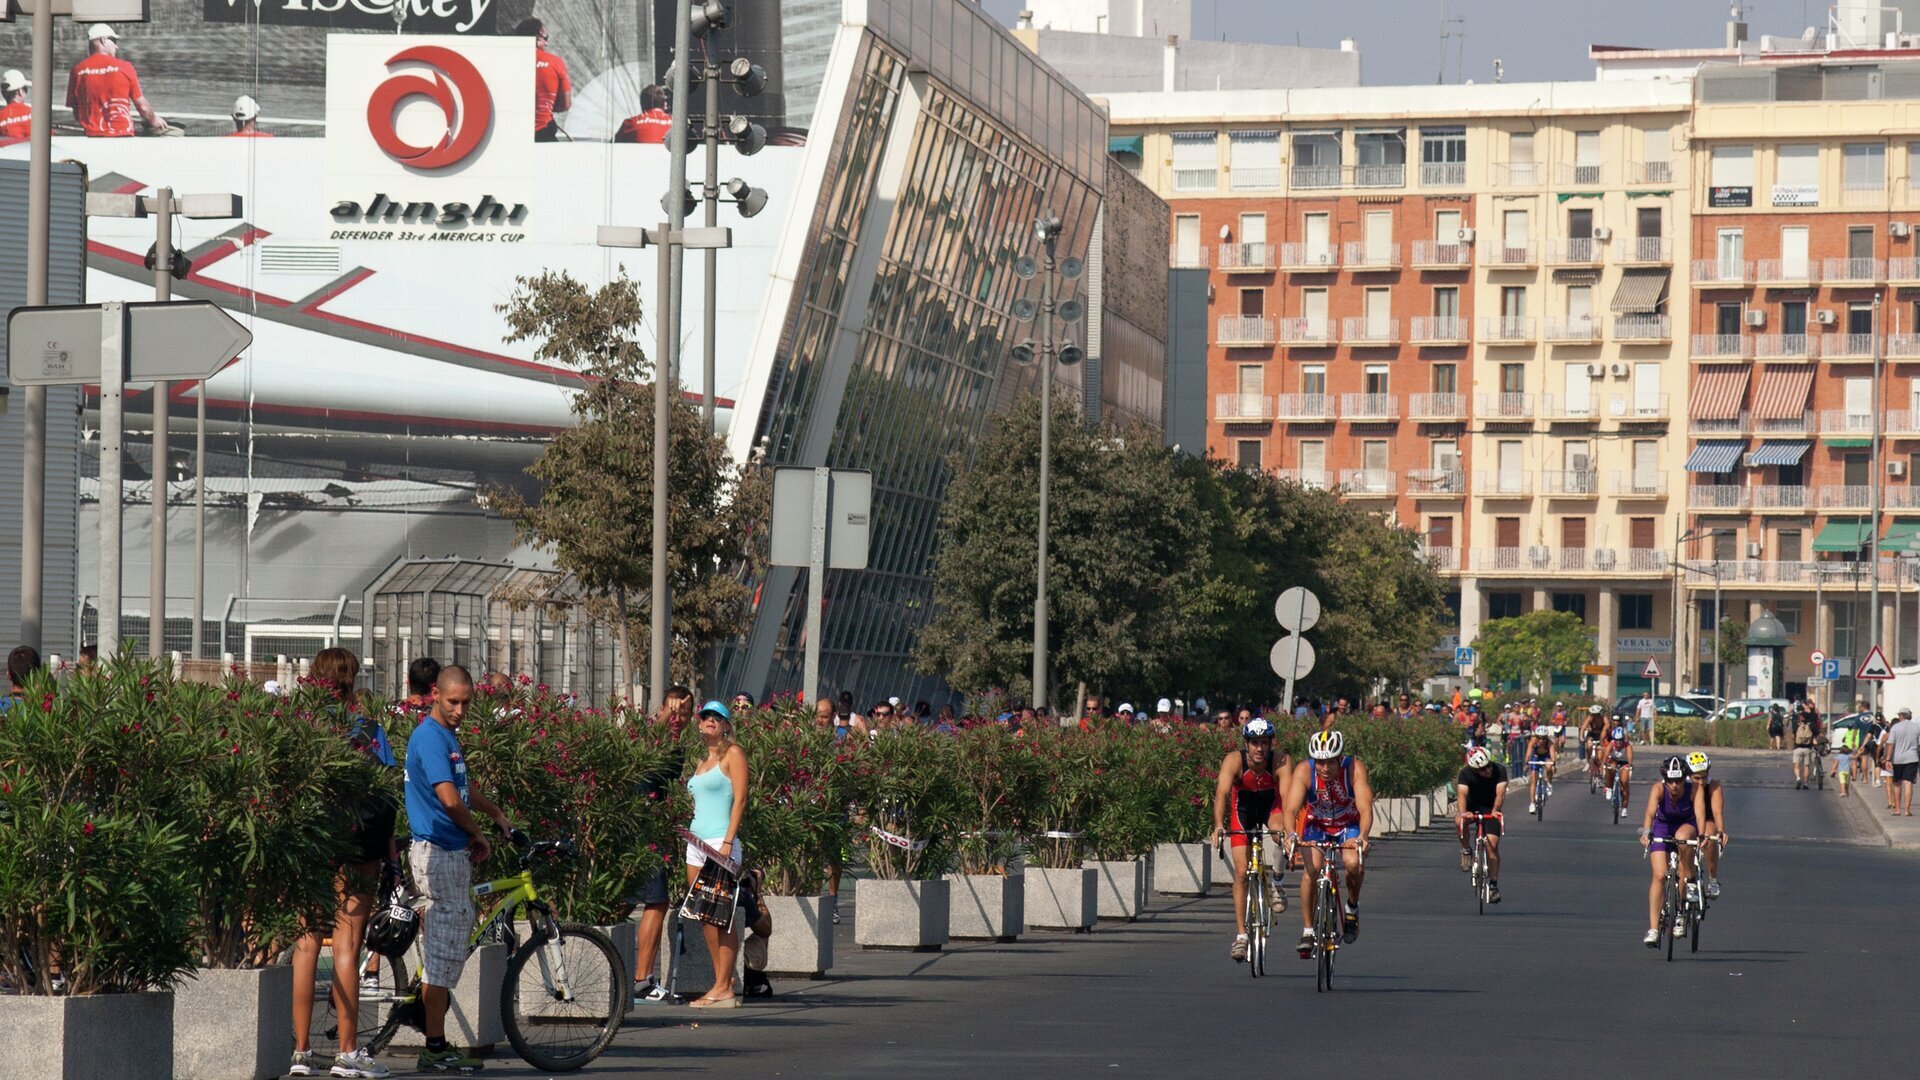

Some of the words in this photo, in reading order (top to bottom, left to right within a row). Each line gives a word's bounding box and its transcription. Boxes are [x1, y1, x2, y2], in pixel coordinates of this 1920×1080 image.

[330, 193, 526, 226] alinghi
[330, 231, 393, 241] DEFENDER
[398, 231, 425, 241] 33rd
[428, 232, 496, 242] AMERICA'S
[500, 233, 525, 243] CUP
[1825, 661, 1836, 678] P
[393, 907, 412, 920] 629
